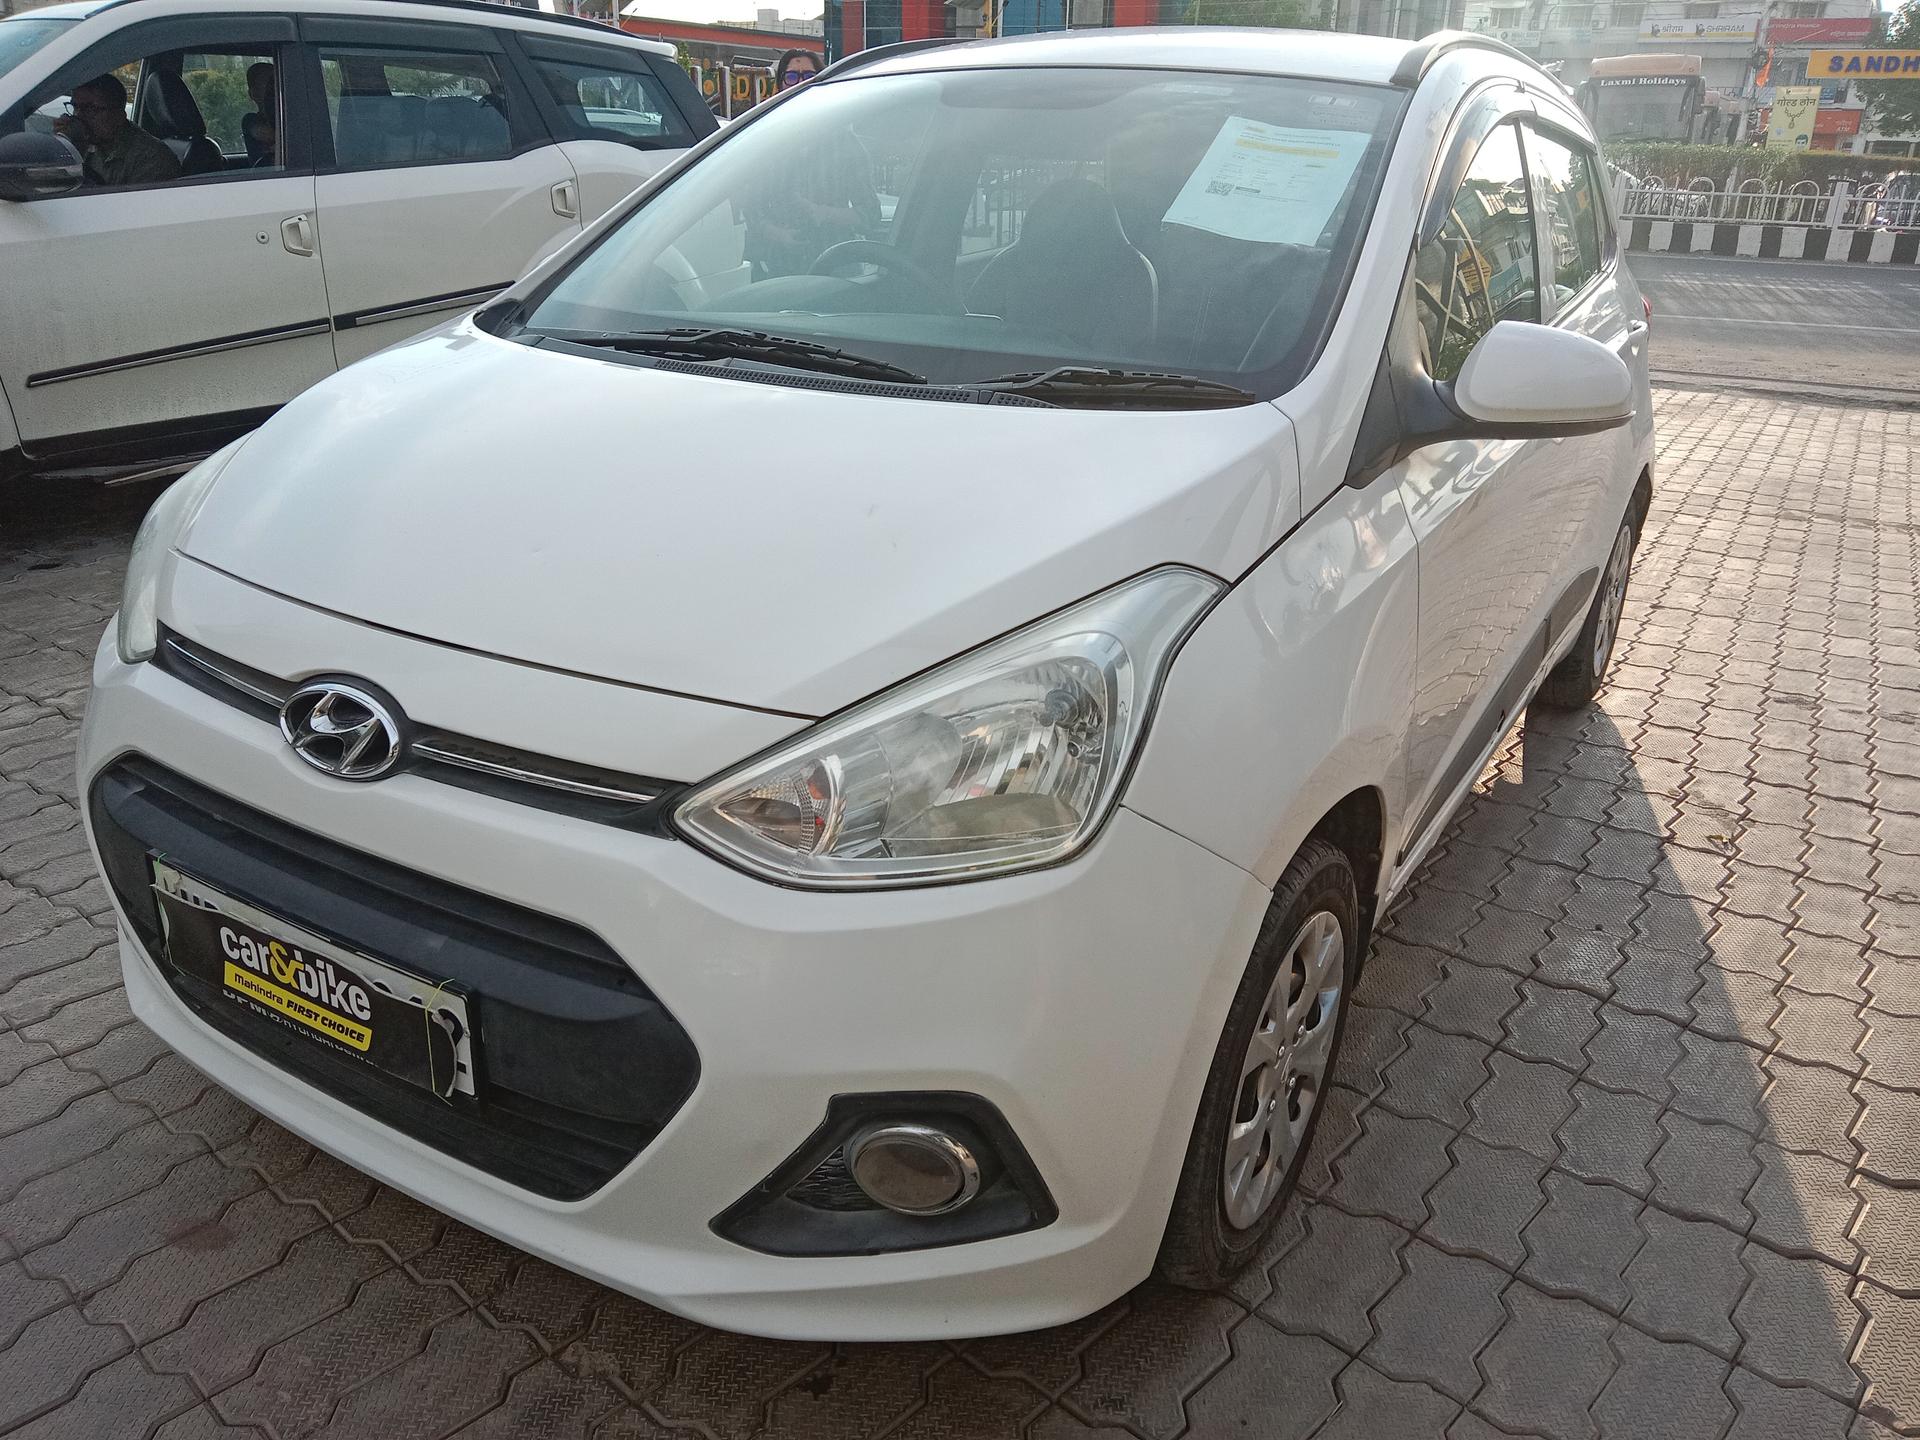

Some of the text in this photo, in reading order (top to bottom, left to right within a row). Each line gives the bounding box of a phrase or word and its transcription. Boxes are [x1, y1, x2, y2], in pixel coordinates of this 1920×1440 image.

[1706, 24, 1745, 33] SHRIRAM
[1828, 55, 1920, 73] SANDH
[1600, 76, 1687, 87] Laxmi Holidays
[1777, 95, 1798, 107] गोल्ड
[286, 999, 321, 1022] FIRST
[320, 1015, 365, 1044] CHOICE
